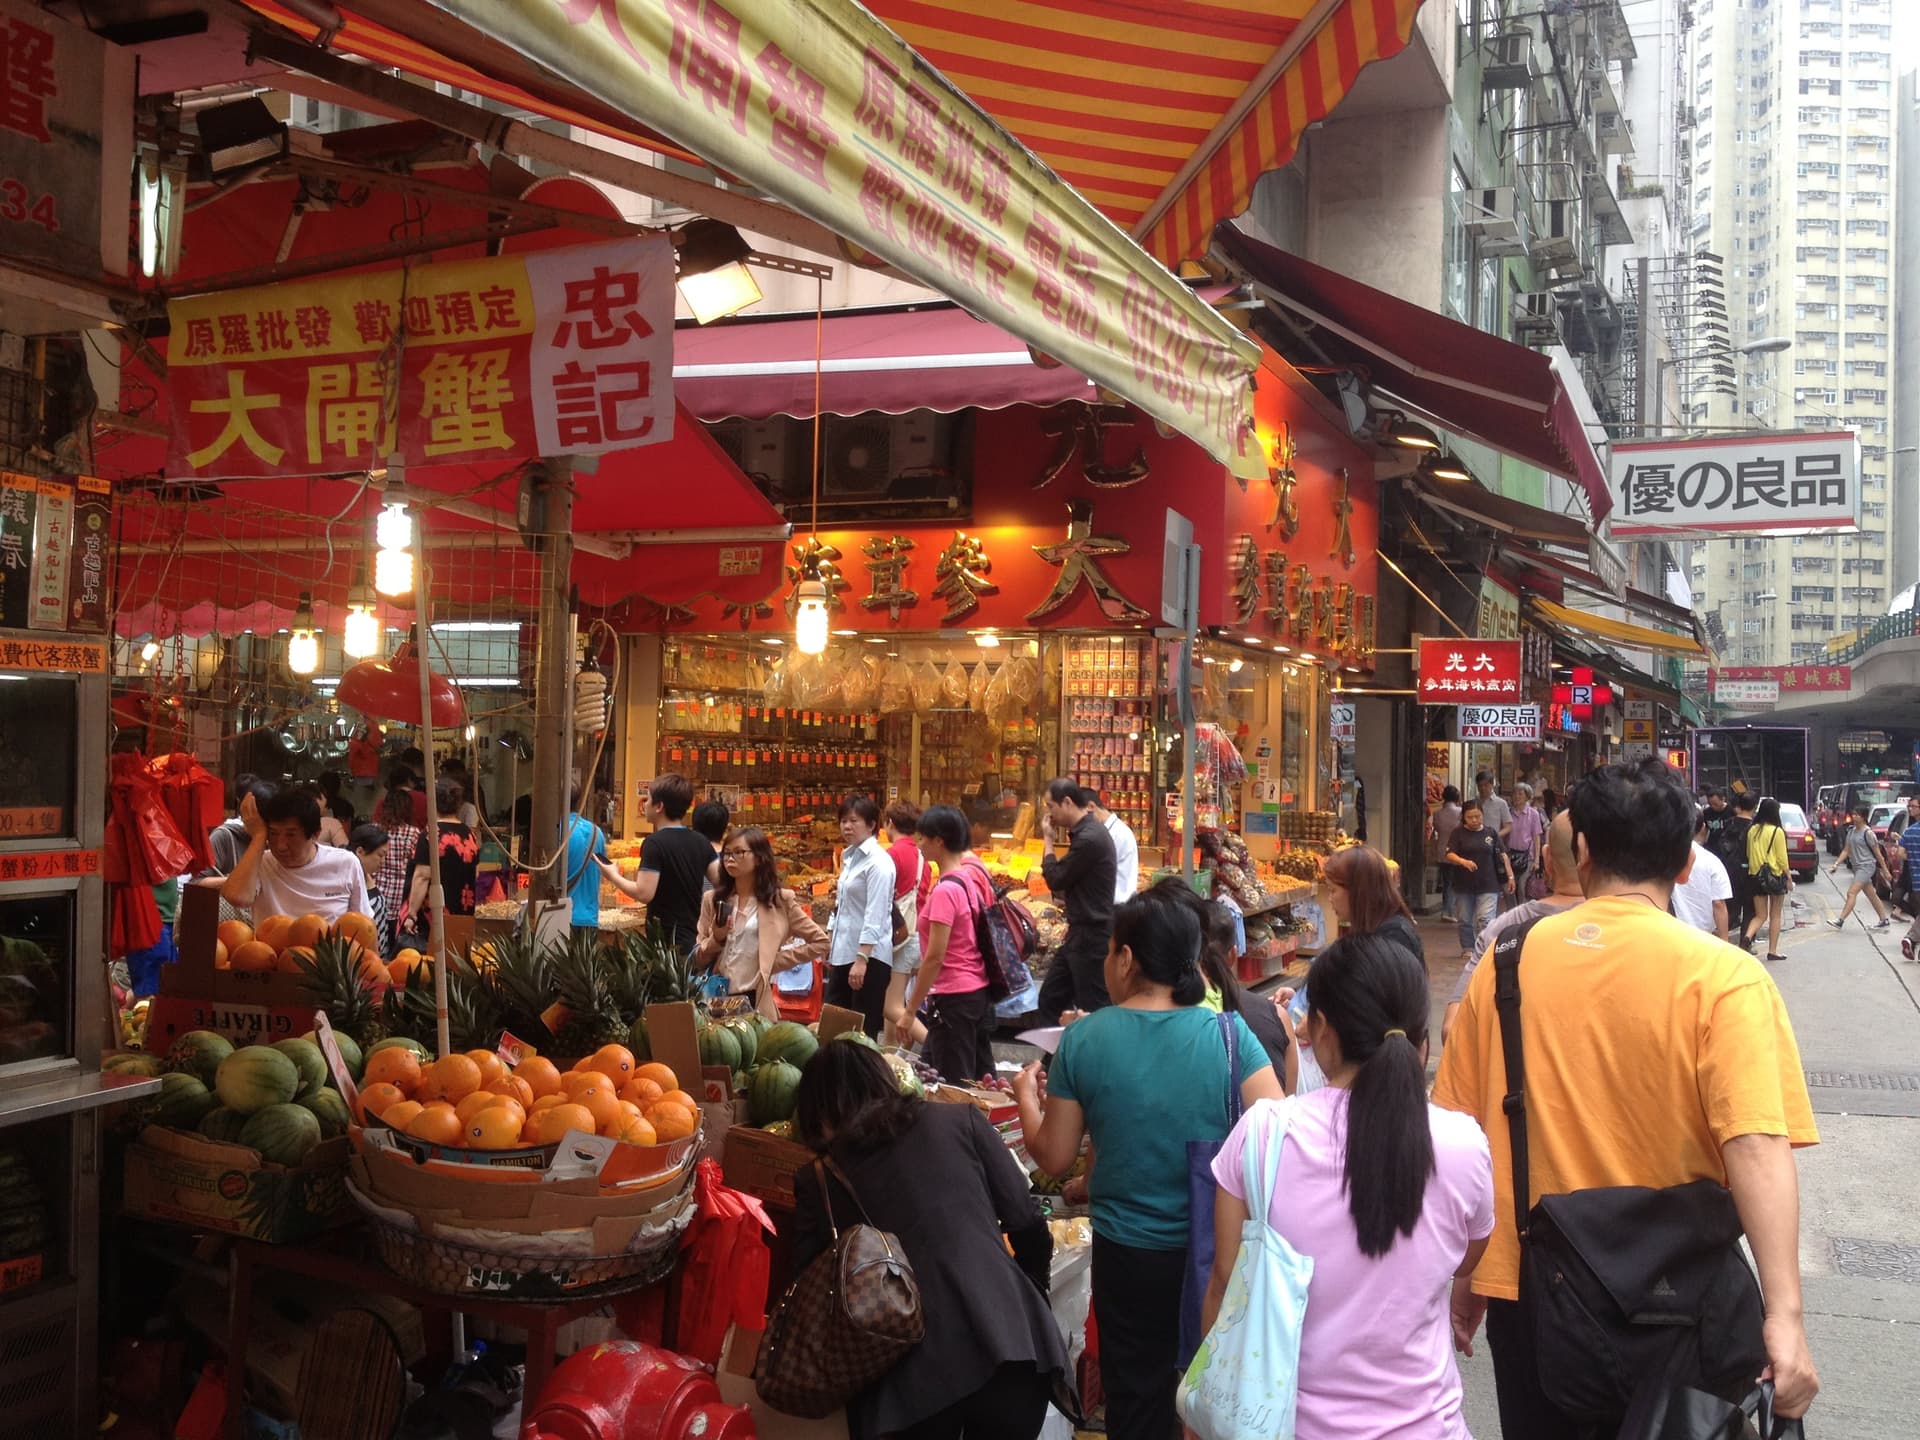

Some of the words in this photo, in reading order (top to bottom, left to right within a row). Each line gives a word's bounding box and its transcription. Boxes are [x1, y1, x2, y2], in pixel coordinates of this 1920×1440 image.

[853, 44, 1011, 226] 原羅批發
[859, 152, 1017, 314] 歡迎預定
[184, 304, 332, 358] 原羅批發
[354, 285, 521, 346] 歡迎預定
[551, 265, 655, 447] 忠記
[185, 348, 516, 469] 大閘蟹
[1620, 454, 1846, 516] 優の良品
[0, 642, 100, 668] 費代客蒸蟹
[1462, 707, 1536, 725] 優の良品
[1466, 726, 1484, 737] AJI
[1488, 726, 1532, 737] ICHIBAN
[193, 1007, 292, 1034] GIRAFFE
[491, 1155, 541, 1169] HAMILTON
